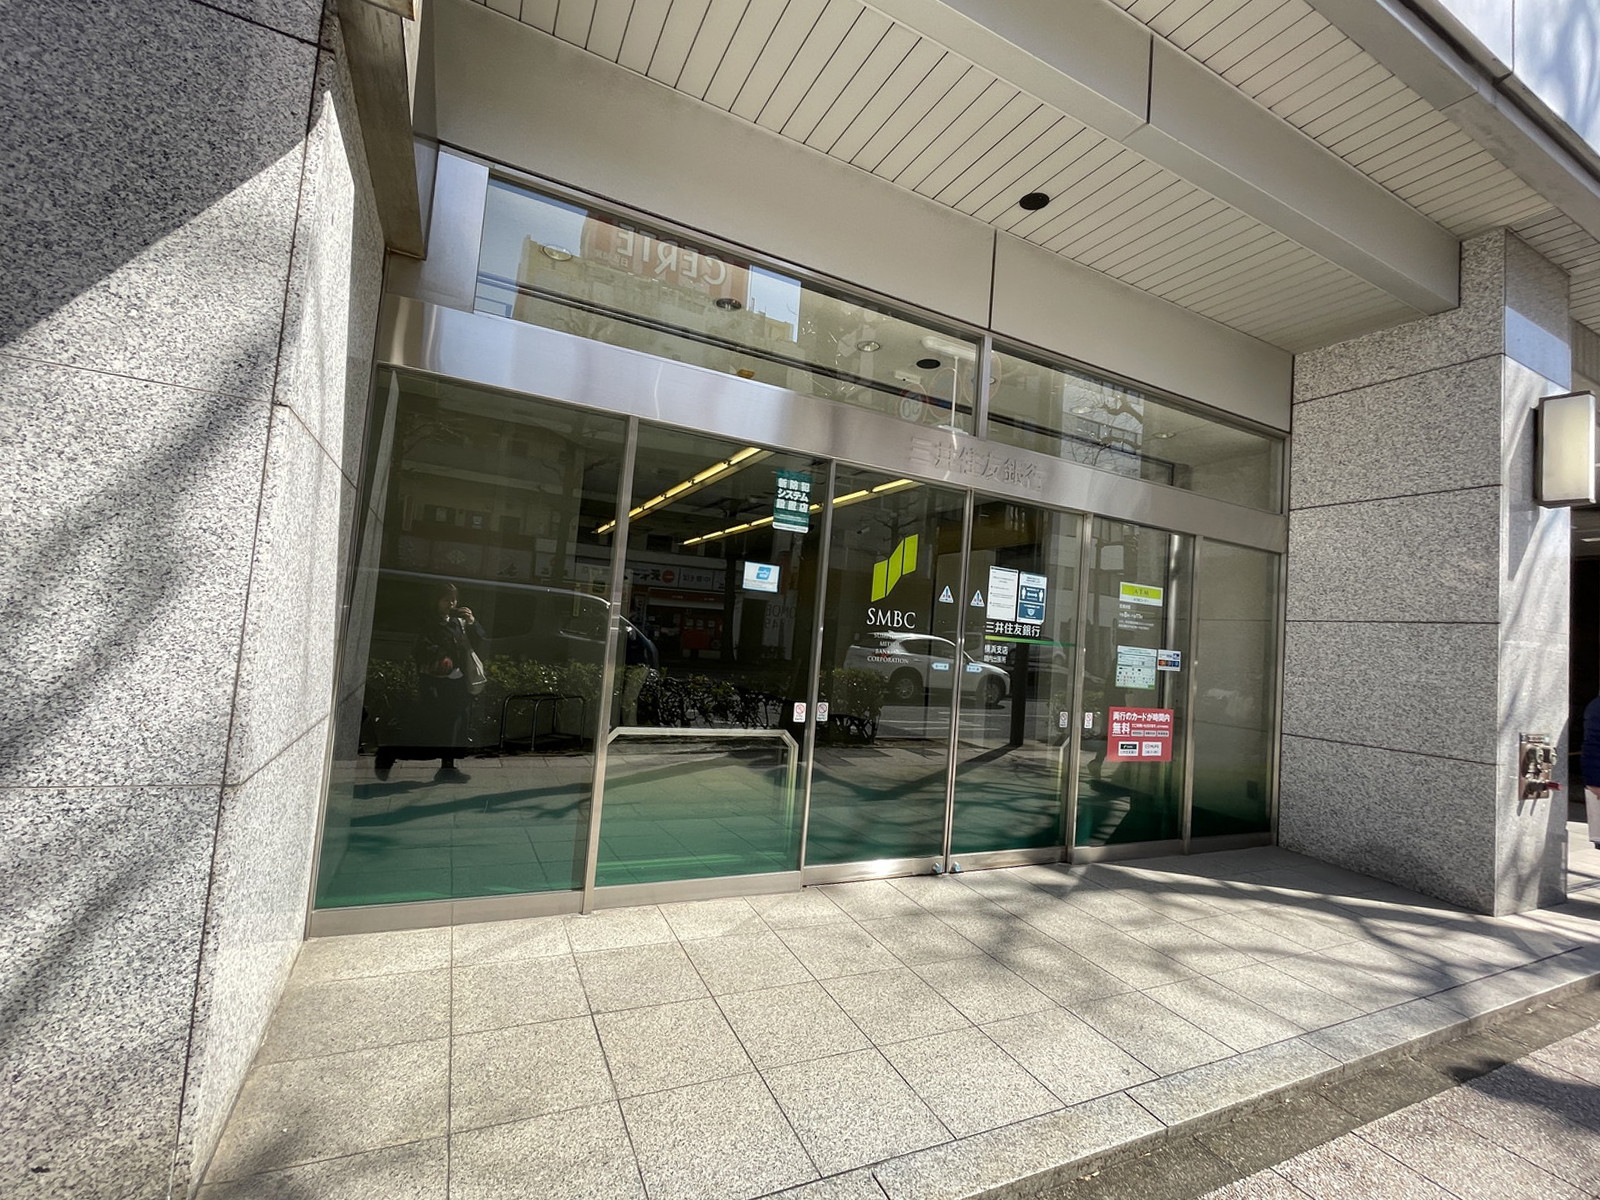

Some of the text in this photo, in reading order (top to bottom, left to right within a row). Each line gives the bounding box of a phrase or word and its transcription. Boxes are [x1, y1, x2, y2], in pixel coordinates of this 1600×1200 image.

[909, 435, 1043, 492] 三井住友銀行
[777, 488, 809, 503] システム
[866, 607, 916, 629] SMBC
[985, 621, 1041, 638] 三井住友銀行
